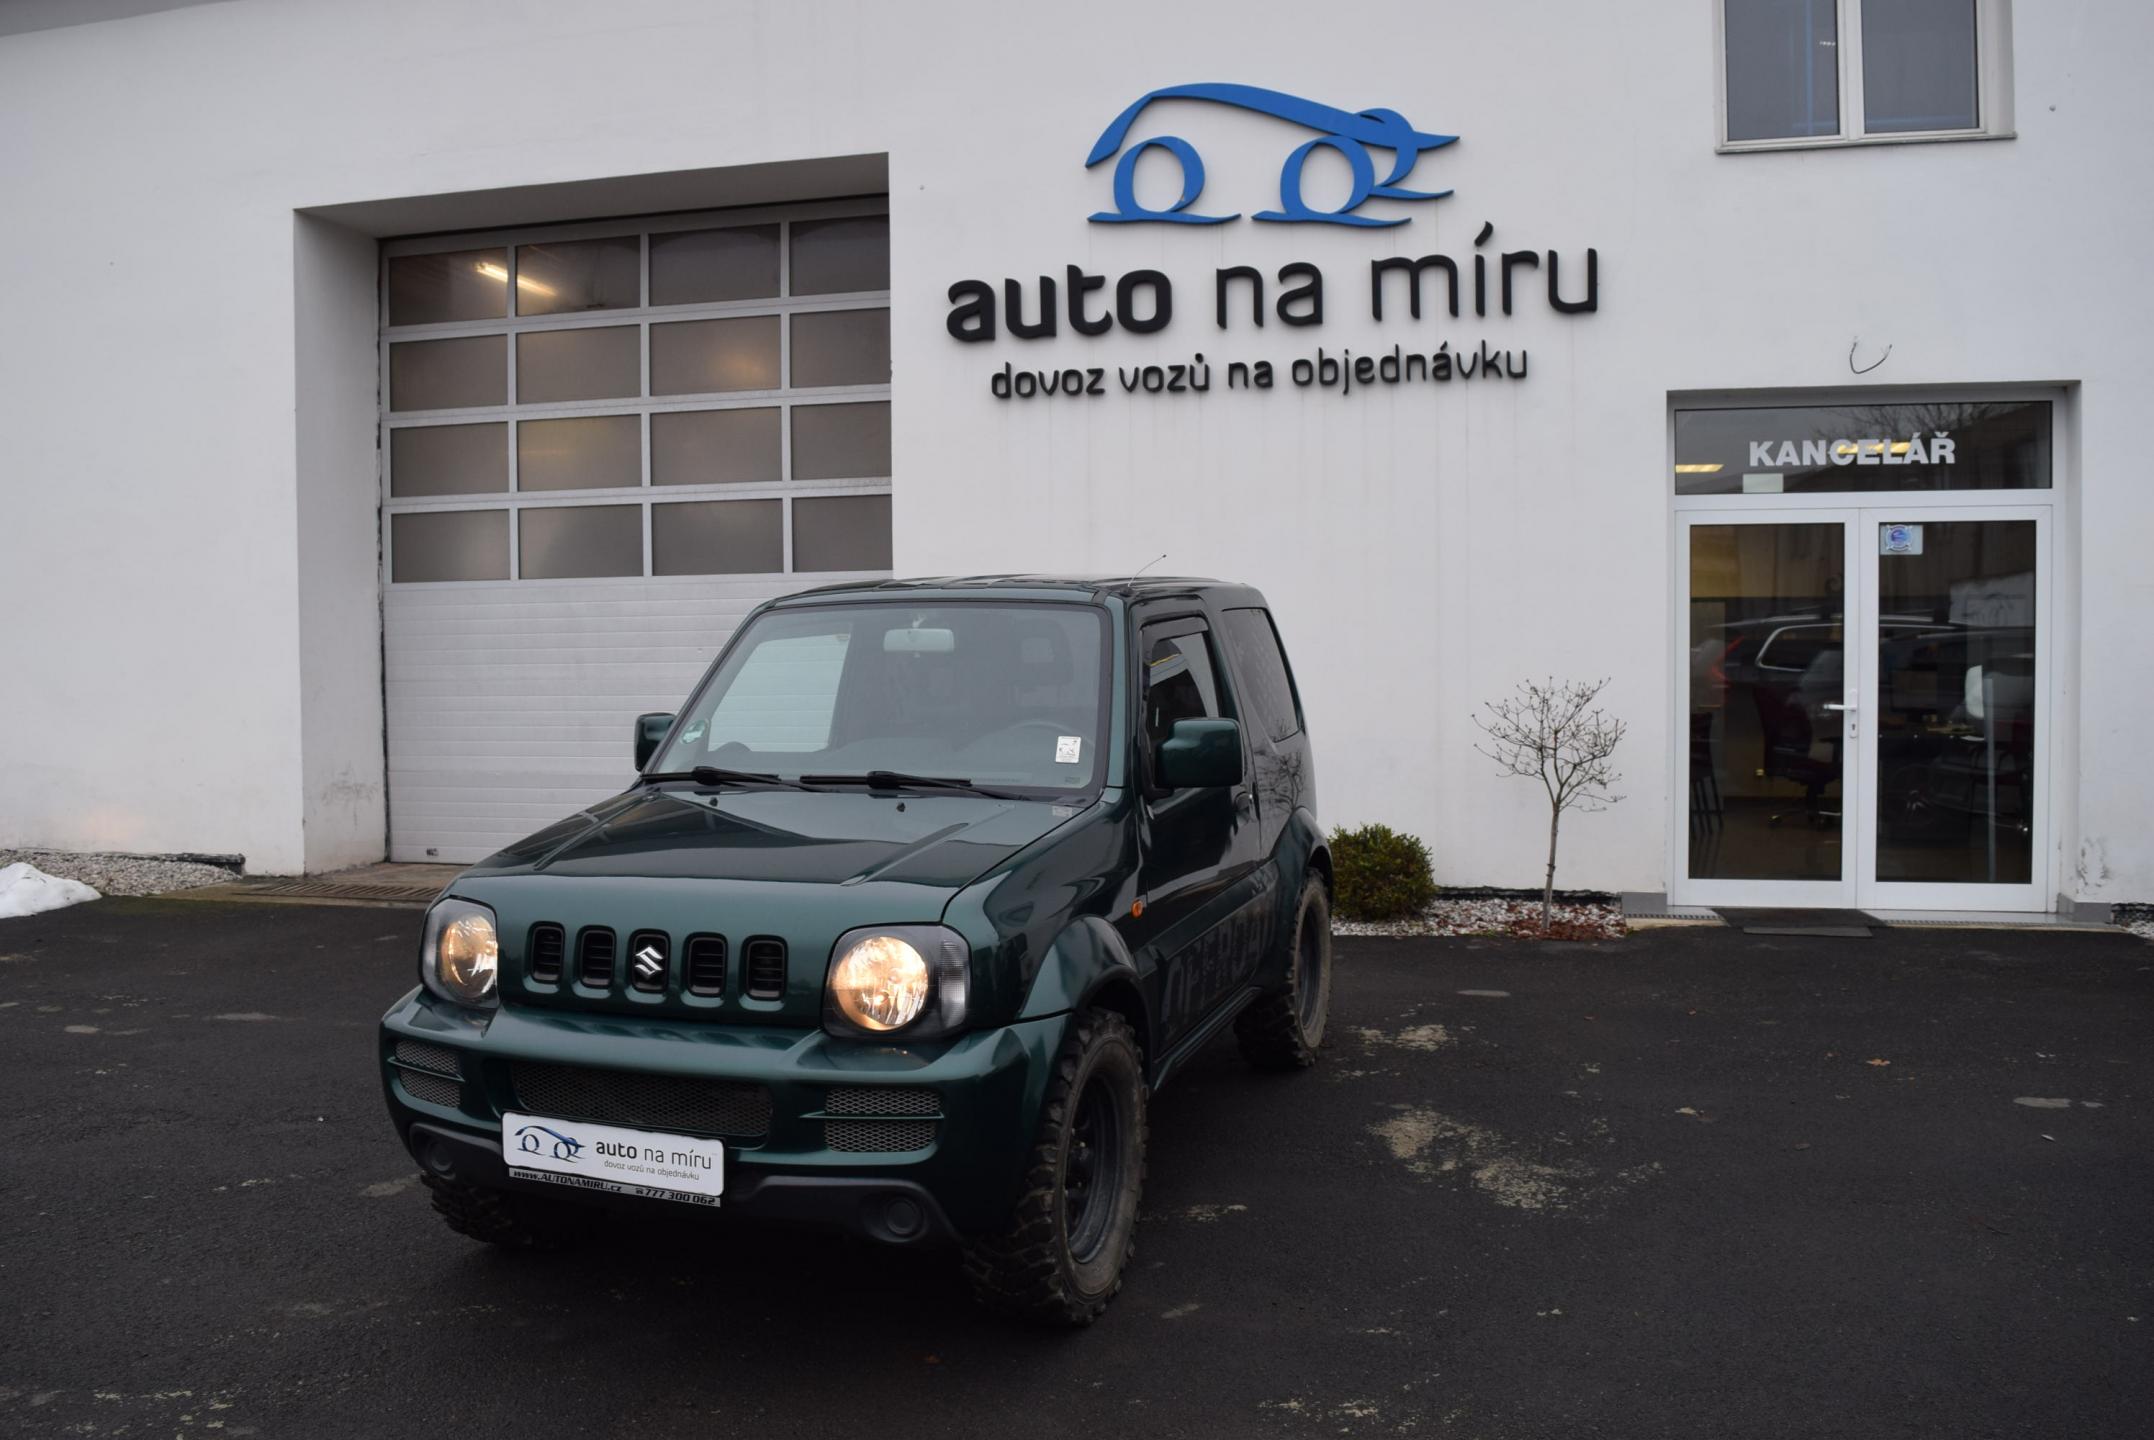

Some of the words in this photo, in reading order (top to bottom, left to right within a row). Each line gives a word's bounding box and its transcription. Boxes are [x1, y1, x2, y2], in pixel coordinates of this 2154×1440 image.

[946, 264, 1172, 342] auto
[1216, 262, 1323, 328] na
[1372, 221, 1598, 322] míru
[991, 362, 1106, 399] dovoz
[1119, 353, 1209, 393] vozů
[1228, 360, 1273, 389] na
[1291, 340, 1528, 394] objednávku
[1749, 431, 1956, 467] KANCELÁŘ
[596, 1141, 637, 1159] auto
[644, 1147, 664, 1163] na
[671, 1149, 712, 1170] míru
[604, 1159, 625, 1170] dovoz
[657, 1167, 700, 1180] objednávku
[645, 1188, 666, 1198] 777
[668, 1192, 691, 1203] 300
